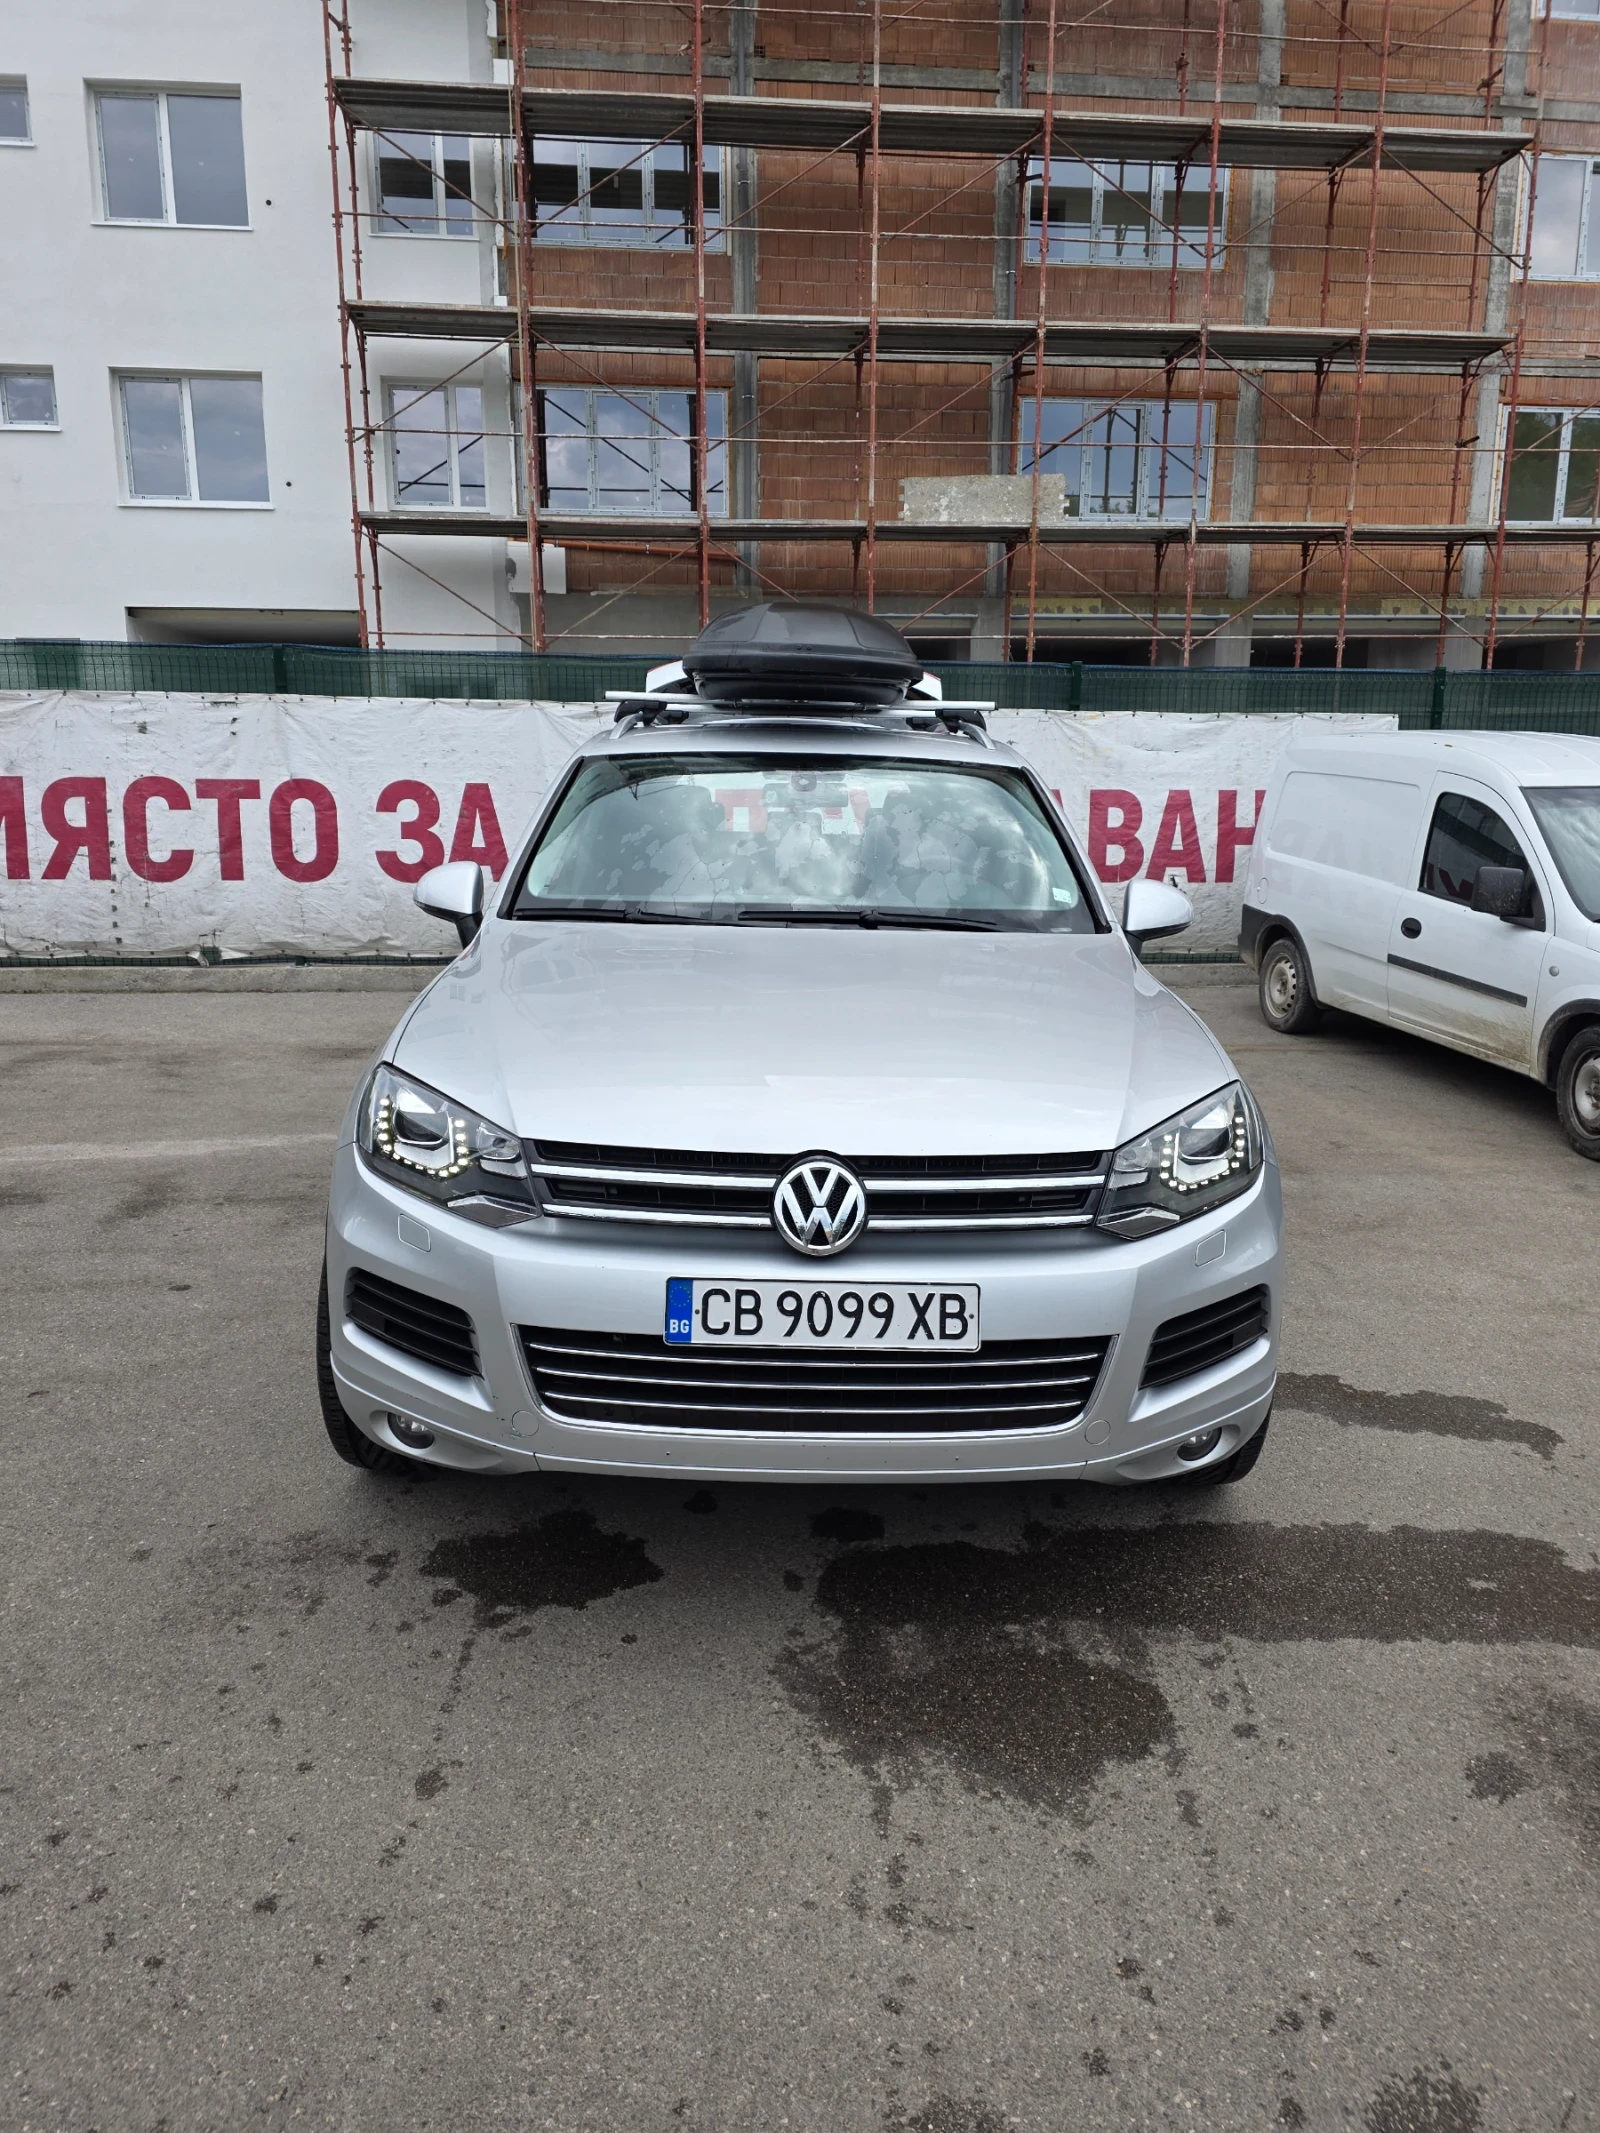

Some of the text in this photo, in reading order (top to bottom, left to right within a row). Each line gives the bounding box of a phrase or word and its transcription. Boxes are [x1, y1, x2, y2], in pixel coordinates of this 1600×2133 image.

[375, 780, 510, 883] ЗА
[777, 1163, 862, 1249] VW
[669, 1319, 690, 1334] BG
[701, 1288, 969, 1340] CB 9099 XB
